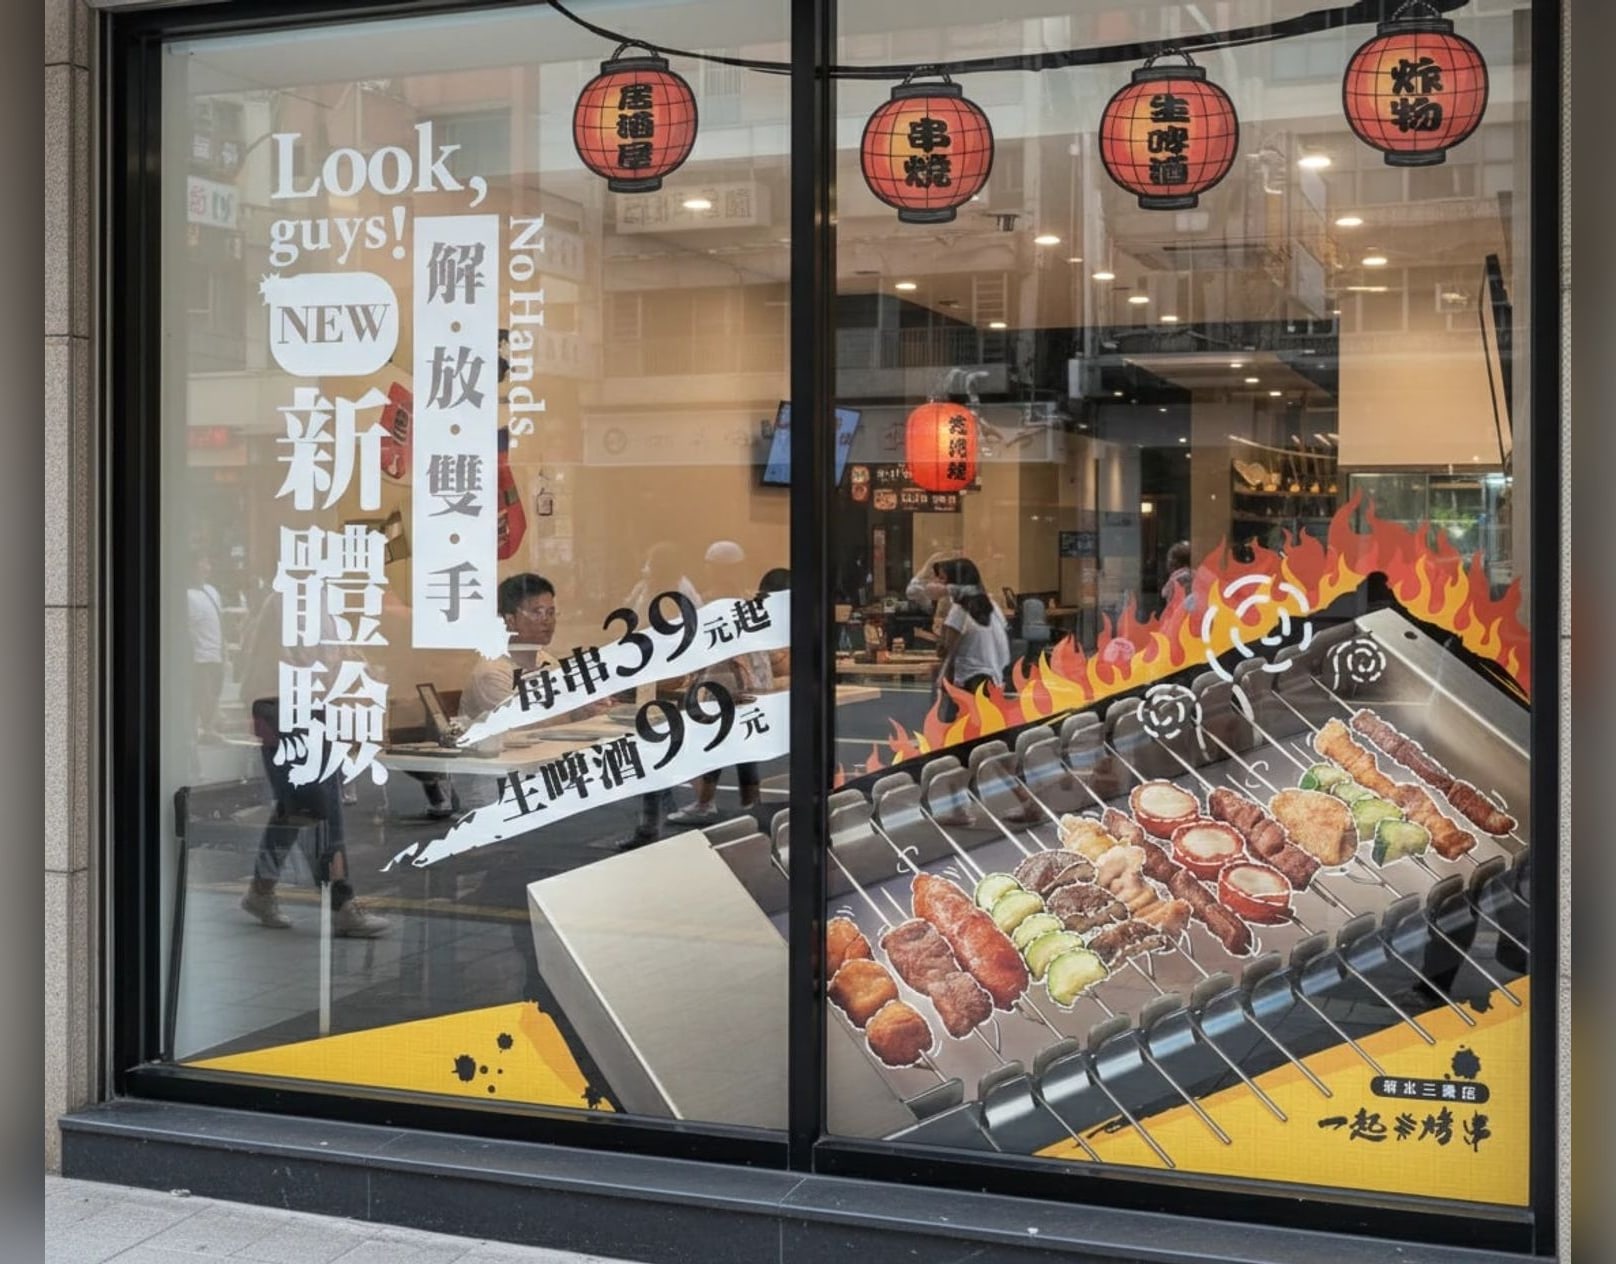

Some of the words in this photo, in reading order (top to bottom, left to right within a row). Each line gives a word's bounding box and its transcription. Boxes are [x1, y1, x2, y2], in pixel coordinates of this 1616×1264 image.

[616, 84, 654, 168] 居酒屋
[1390, 56, 1443, 132] 炸物
[271, 121, 487, 208] Look,
[1147, 94, 1190, 184] 生啤酒
[269, 205, 406, 266] guys!
[508, 215, 545, 282] No
[278, 303, 390, 345] NEW
[508, 288, 546, 448] Hands.
[273, 386, 393, 788] 新體驗
[513, 591, 772, 712] 每串39元起
[497, 681, 770, 823] 生啤酒99元
